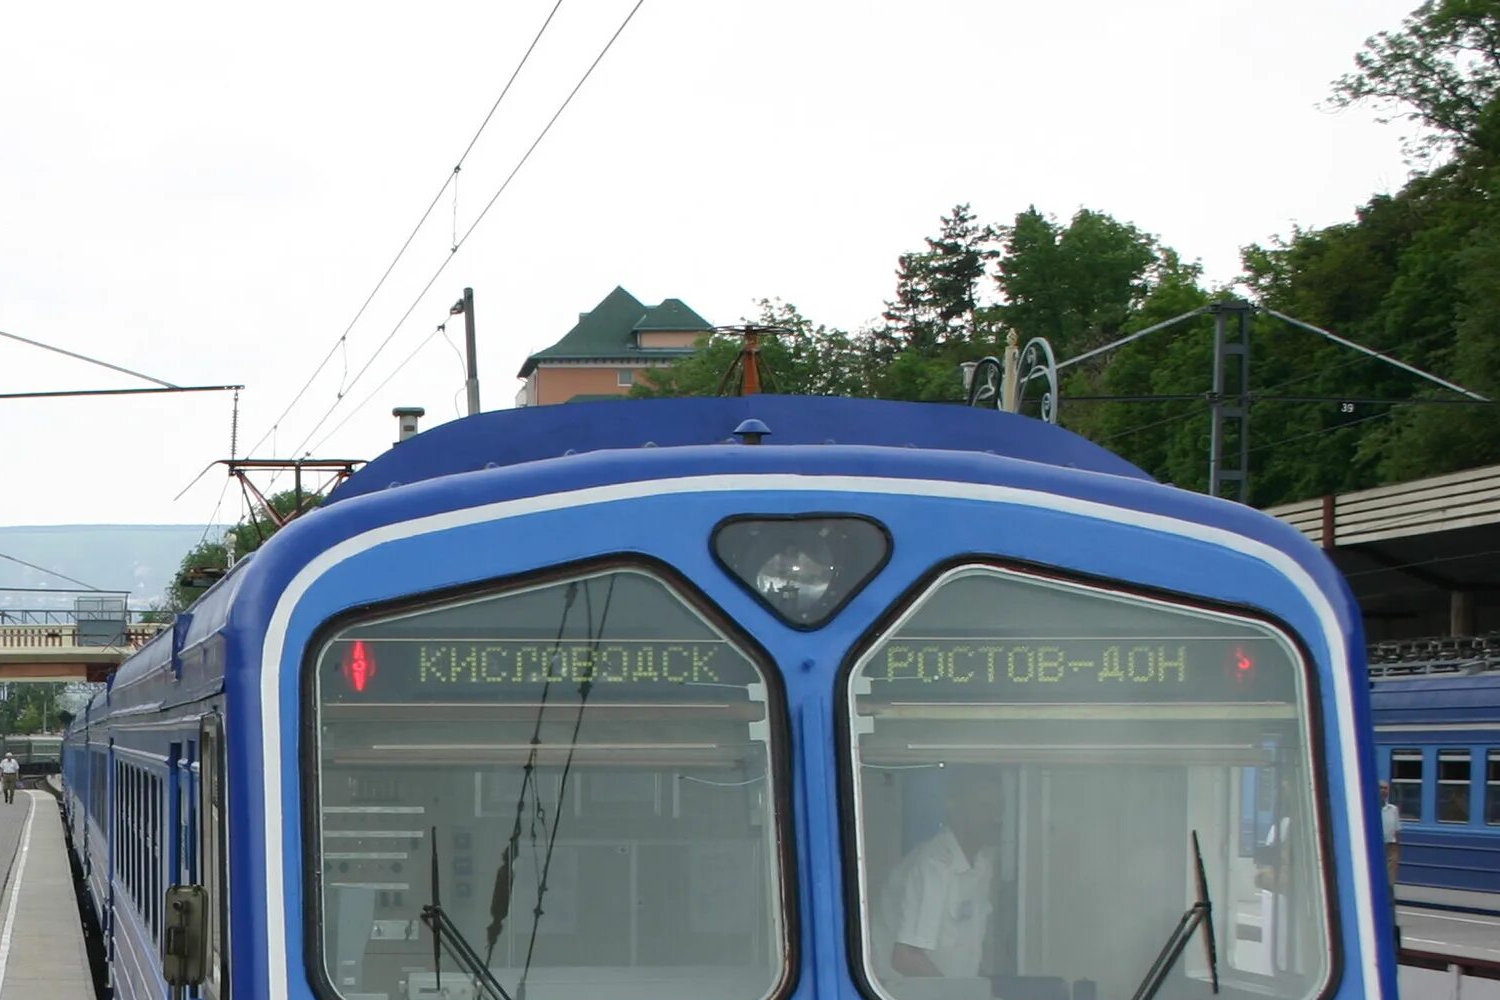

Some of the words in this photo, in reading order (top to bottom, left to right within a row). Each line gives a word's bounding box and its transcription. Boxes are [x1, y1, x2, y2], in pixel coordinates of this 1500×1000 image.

[1341, 402, 1354, 413] 39
[419, 645, 719, 683] КИСЛОВОДСК
[887, 644, 1187, 683] РОСТОВ-ДОН
